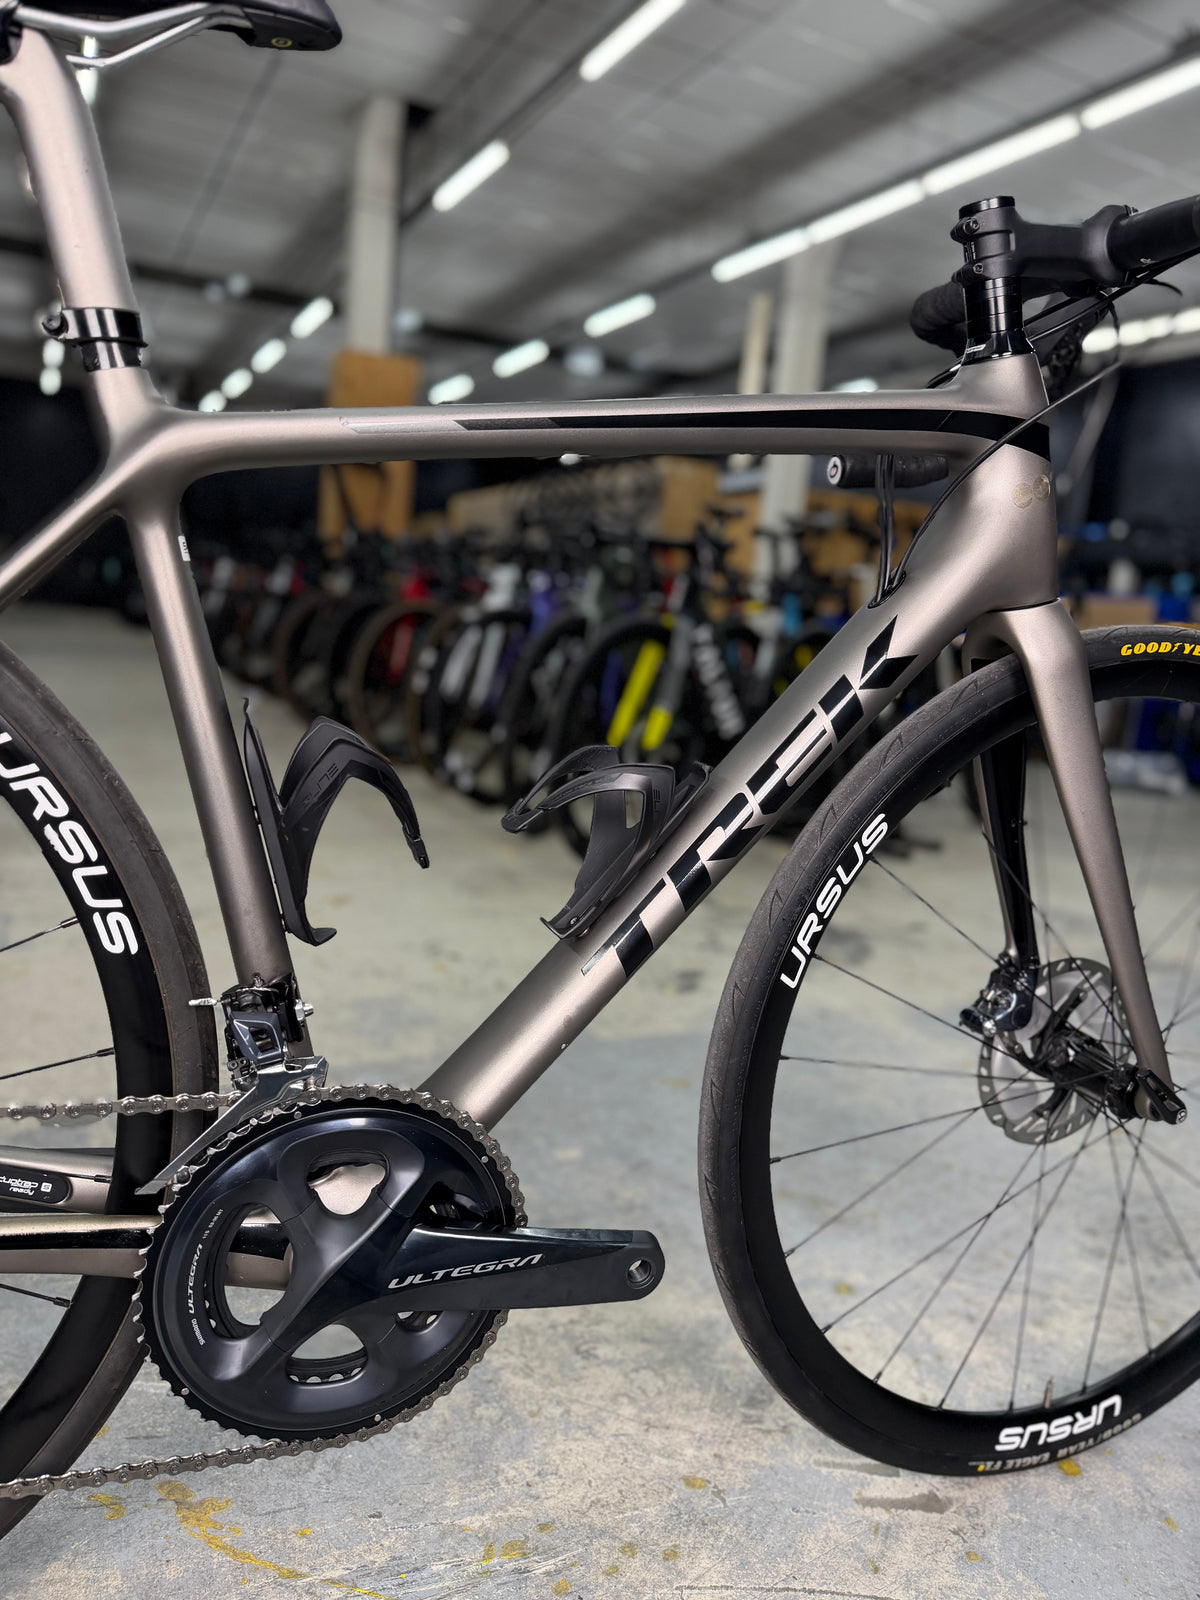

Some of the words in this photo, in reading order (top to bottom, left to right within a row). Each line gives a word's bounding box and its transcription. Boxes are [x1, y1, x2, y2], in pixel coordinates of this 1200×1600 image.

[581, 614, 918, 978] TREK
[780, 813, 888, 989] URSUS
[9, 1186, 34, 1196] ready
[187, 1243, 203, 1314] ULTEGRA
[388, 1253, 543, 1289] ULTEGRA
[995, 1394, 1122, 1451] URSUS
[1004, 1452, 1050, 1467] EAGLE
